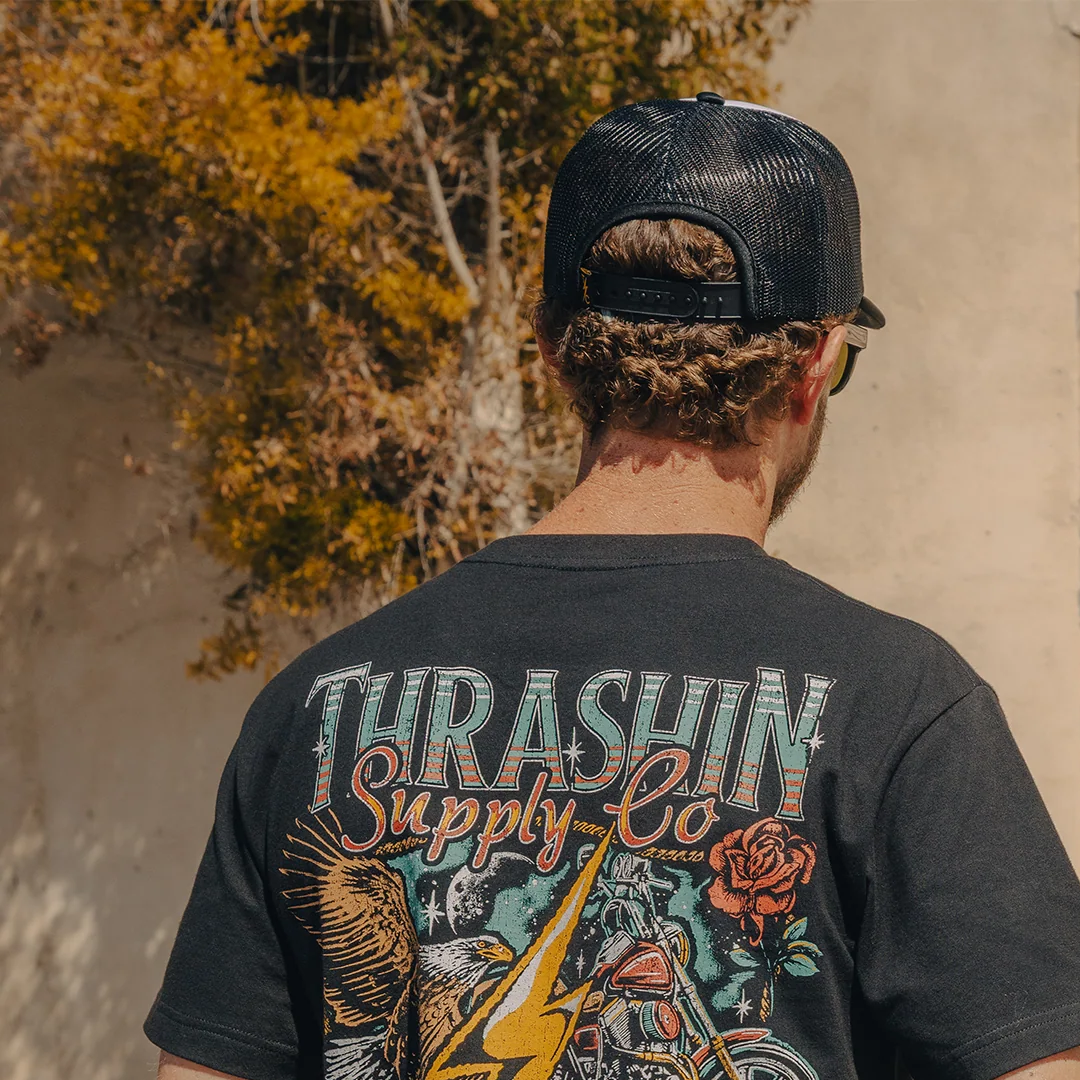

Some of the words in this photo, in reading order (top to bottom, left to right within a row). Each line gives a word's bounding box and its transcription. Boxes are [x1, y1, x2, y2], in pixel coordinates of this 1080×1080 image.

[306, 661, 836, 820] THRASHIN
[341, 744, 577, 871] Supply
[604, 746, 720, 849] Co
